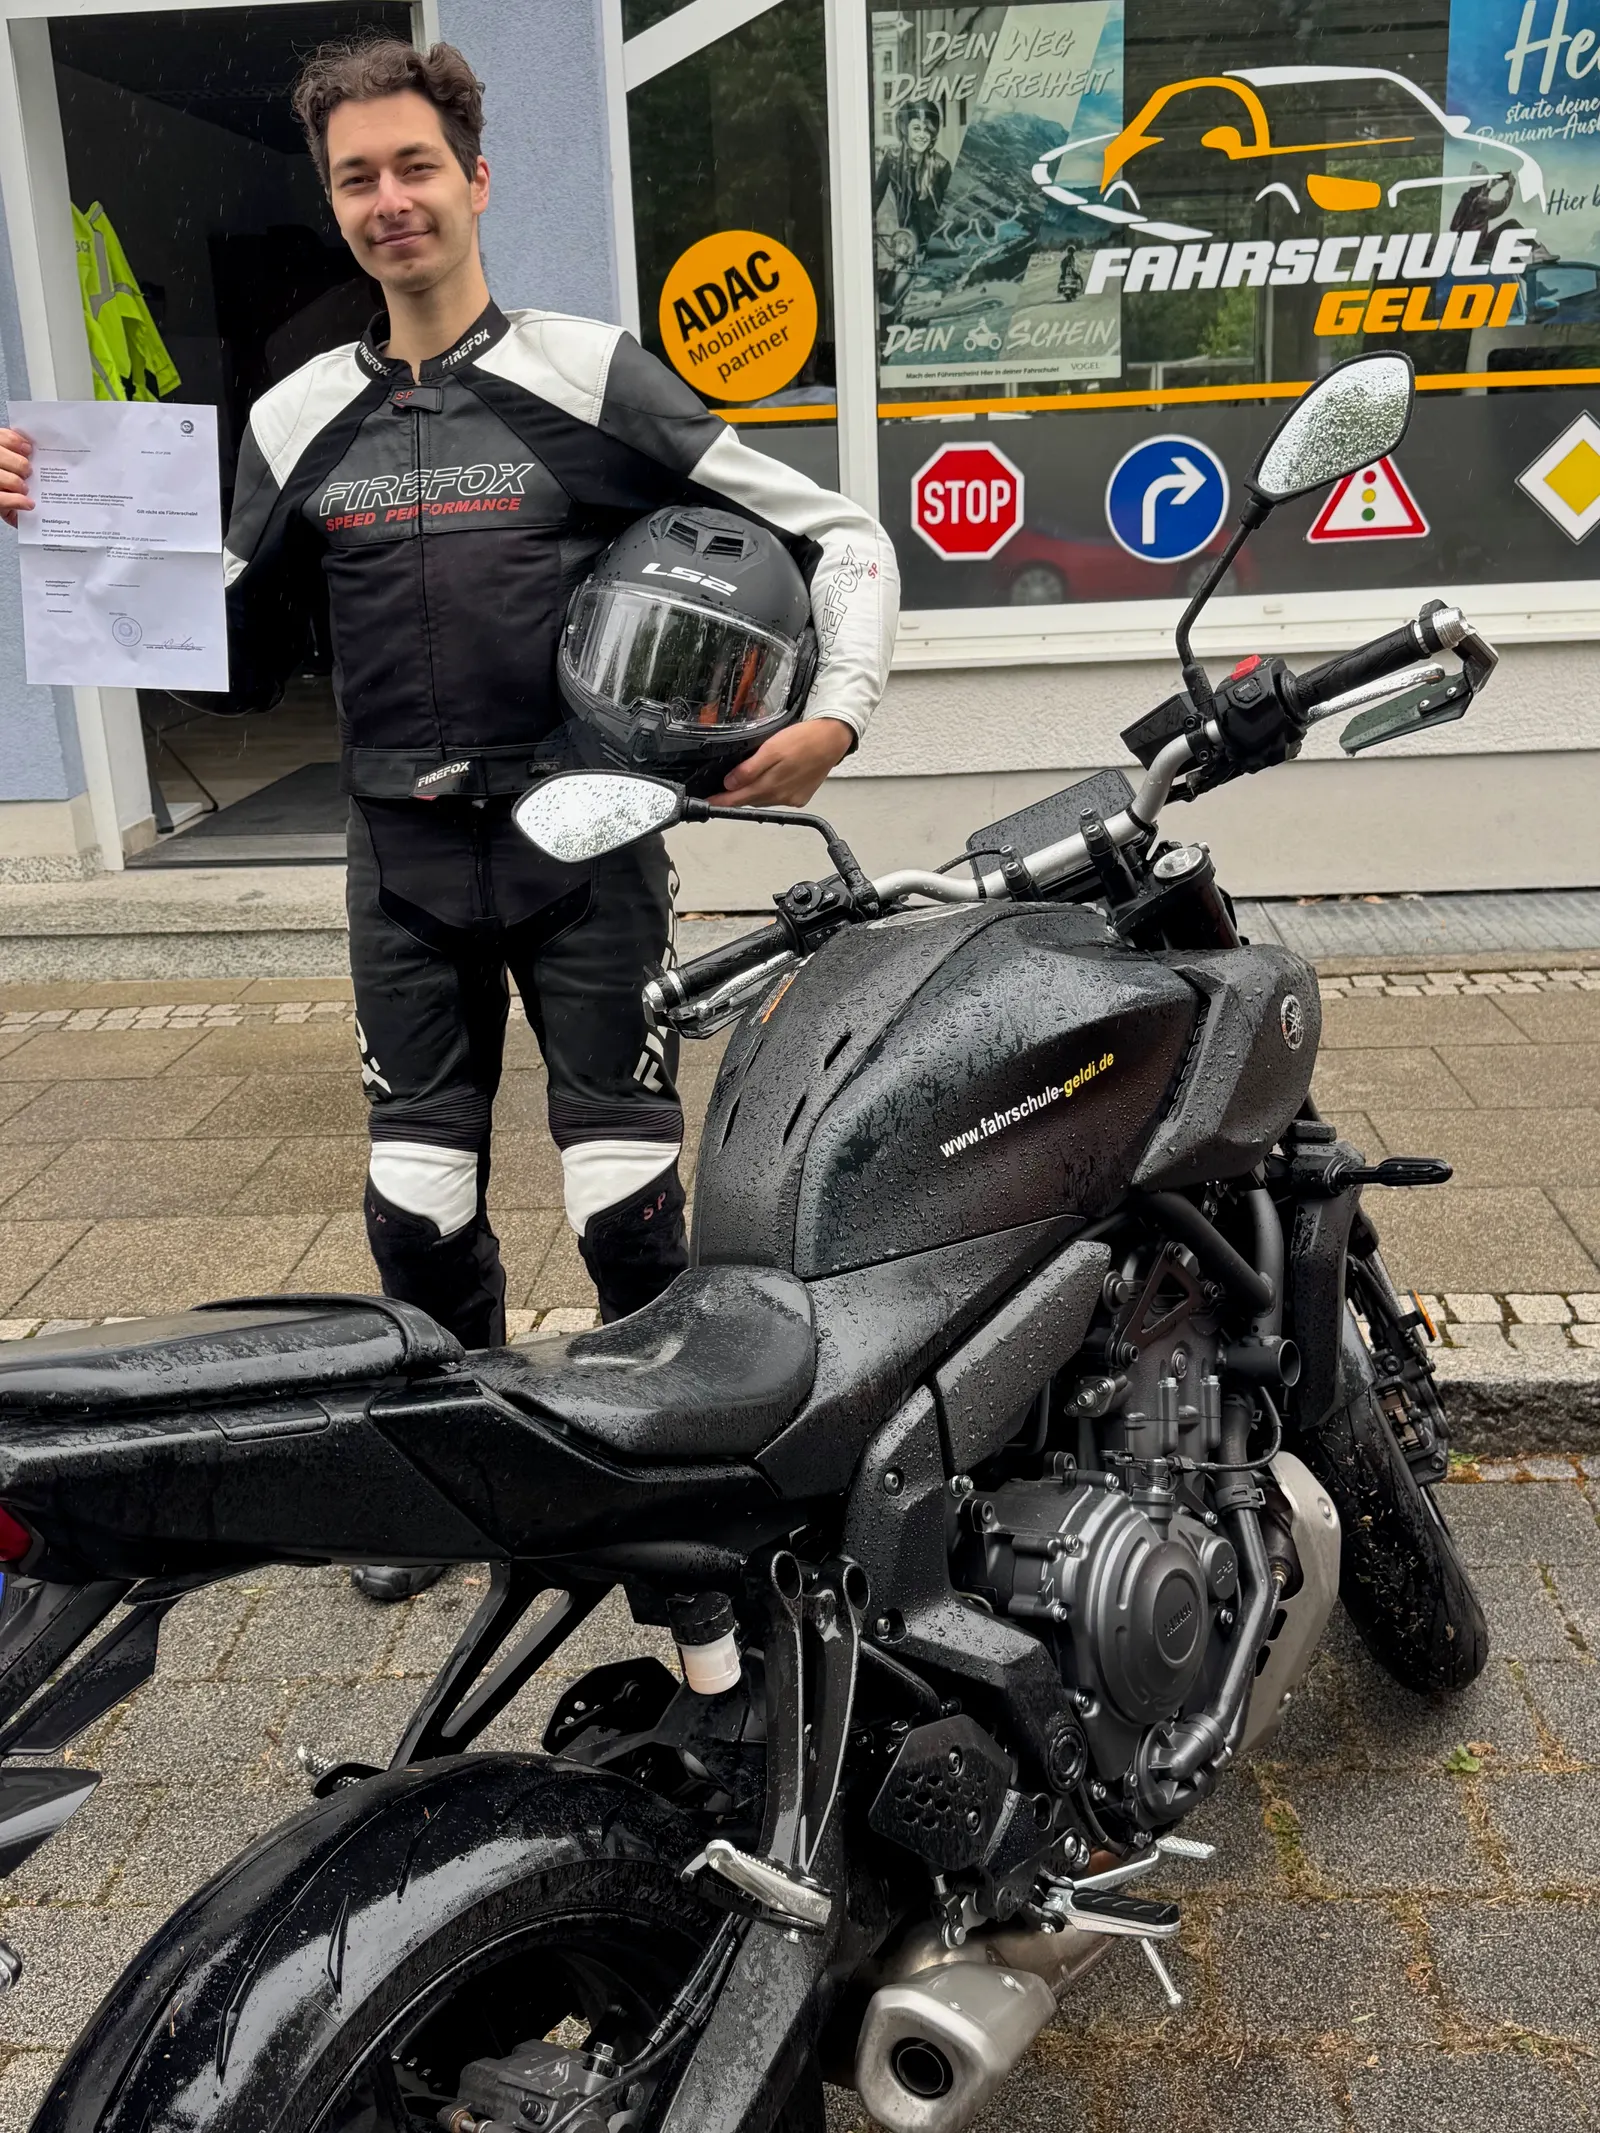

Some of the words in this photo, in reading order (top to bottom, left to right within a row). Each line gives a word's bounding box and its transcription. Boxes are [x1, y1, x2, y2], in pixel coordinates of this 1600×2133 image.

[922, 31, 998, 66] DEIN
[1004, 26, 1075, 62] WEG
[1504, 0, 1600, 95] He
[888, 73, 978, 108] DEINE
[981, 68, 1114, 104] FREIHEIT
[1505, 98, 1554, 124] starte
[1555, 94, 1600, 116] deine
[1547, 188, 1588, 215] Hier
[1592, 184, 1600, 207] b
[1084, 228, 1537, 295] FAHRSCHULE
[673, 250, 780, 344] ADAC
[1313, 282, 1520, 337] GELDI
[441, 329, 491, 370] FIREFOX
[687, 298, 795, 366] Mobilitäts-
[882, 325, 955, 357] DEIN
[1006, 318, 1116, 350] SCHEIN
[359, 341, 392, 376] FIREFOX
[717, 326, 789, 384] partner
[395, 390, 414, 400] SP
[319, 463, 535, 517] FIREFOX
[923, 479, 1011, 525] STOP
[326, 512, 376, 532] SPEED
[385, 498, 522, 523] PERFORMANCE
[641, 562, 738, 597] LS2
[868, 562, 879, 579] SP
[417, 760, 471, 787] FIREFOX
[939, 1052, 1114, 1158] www.fahrschule-geldi.de
[643, 1191, 666, 1220] SP
